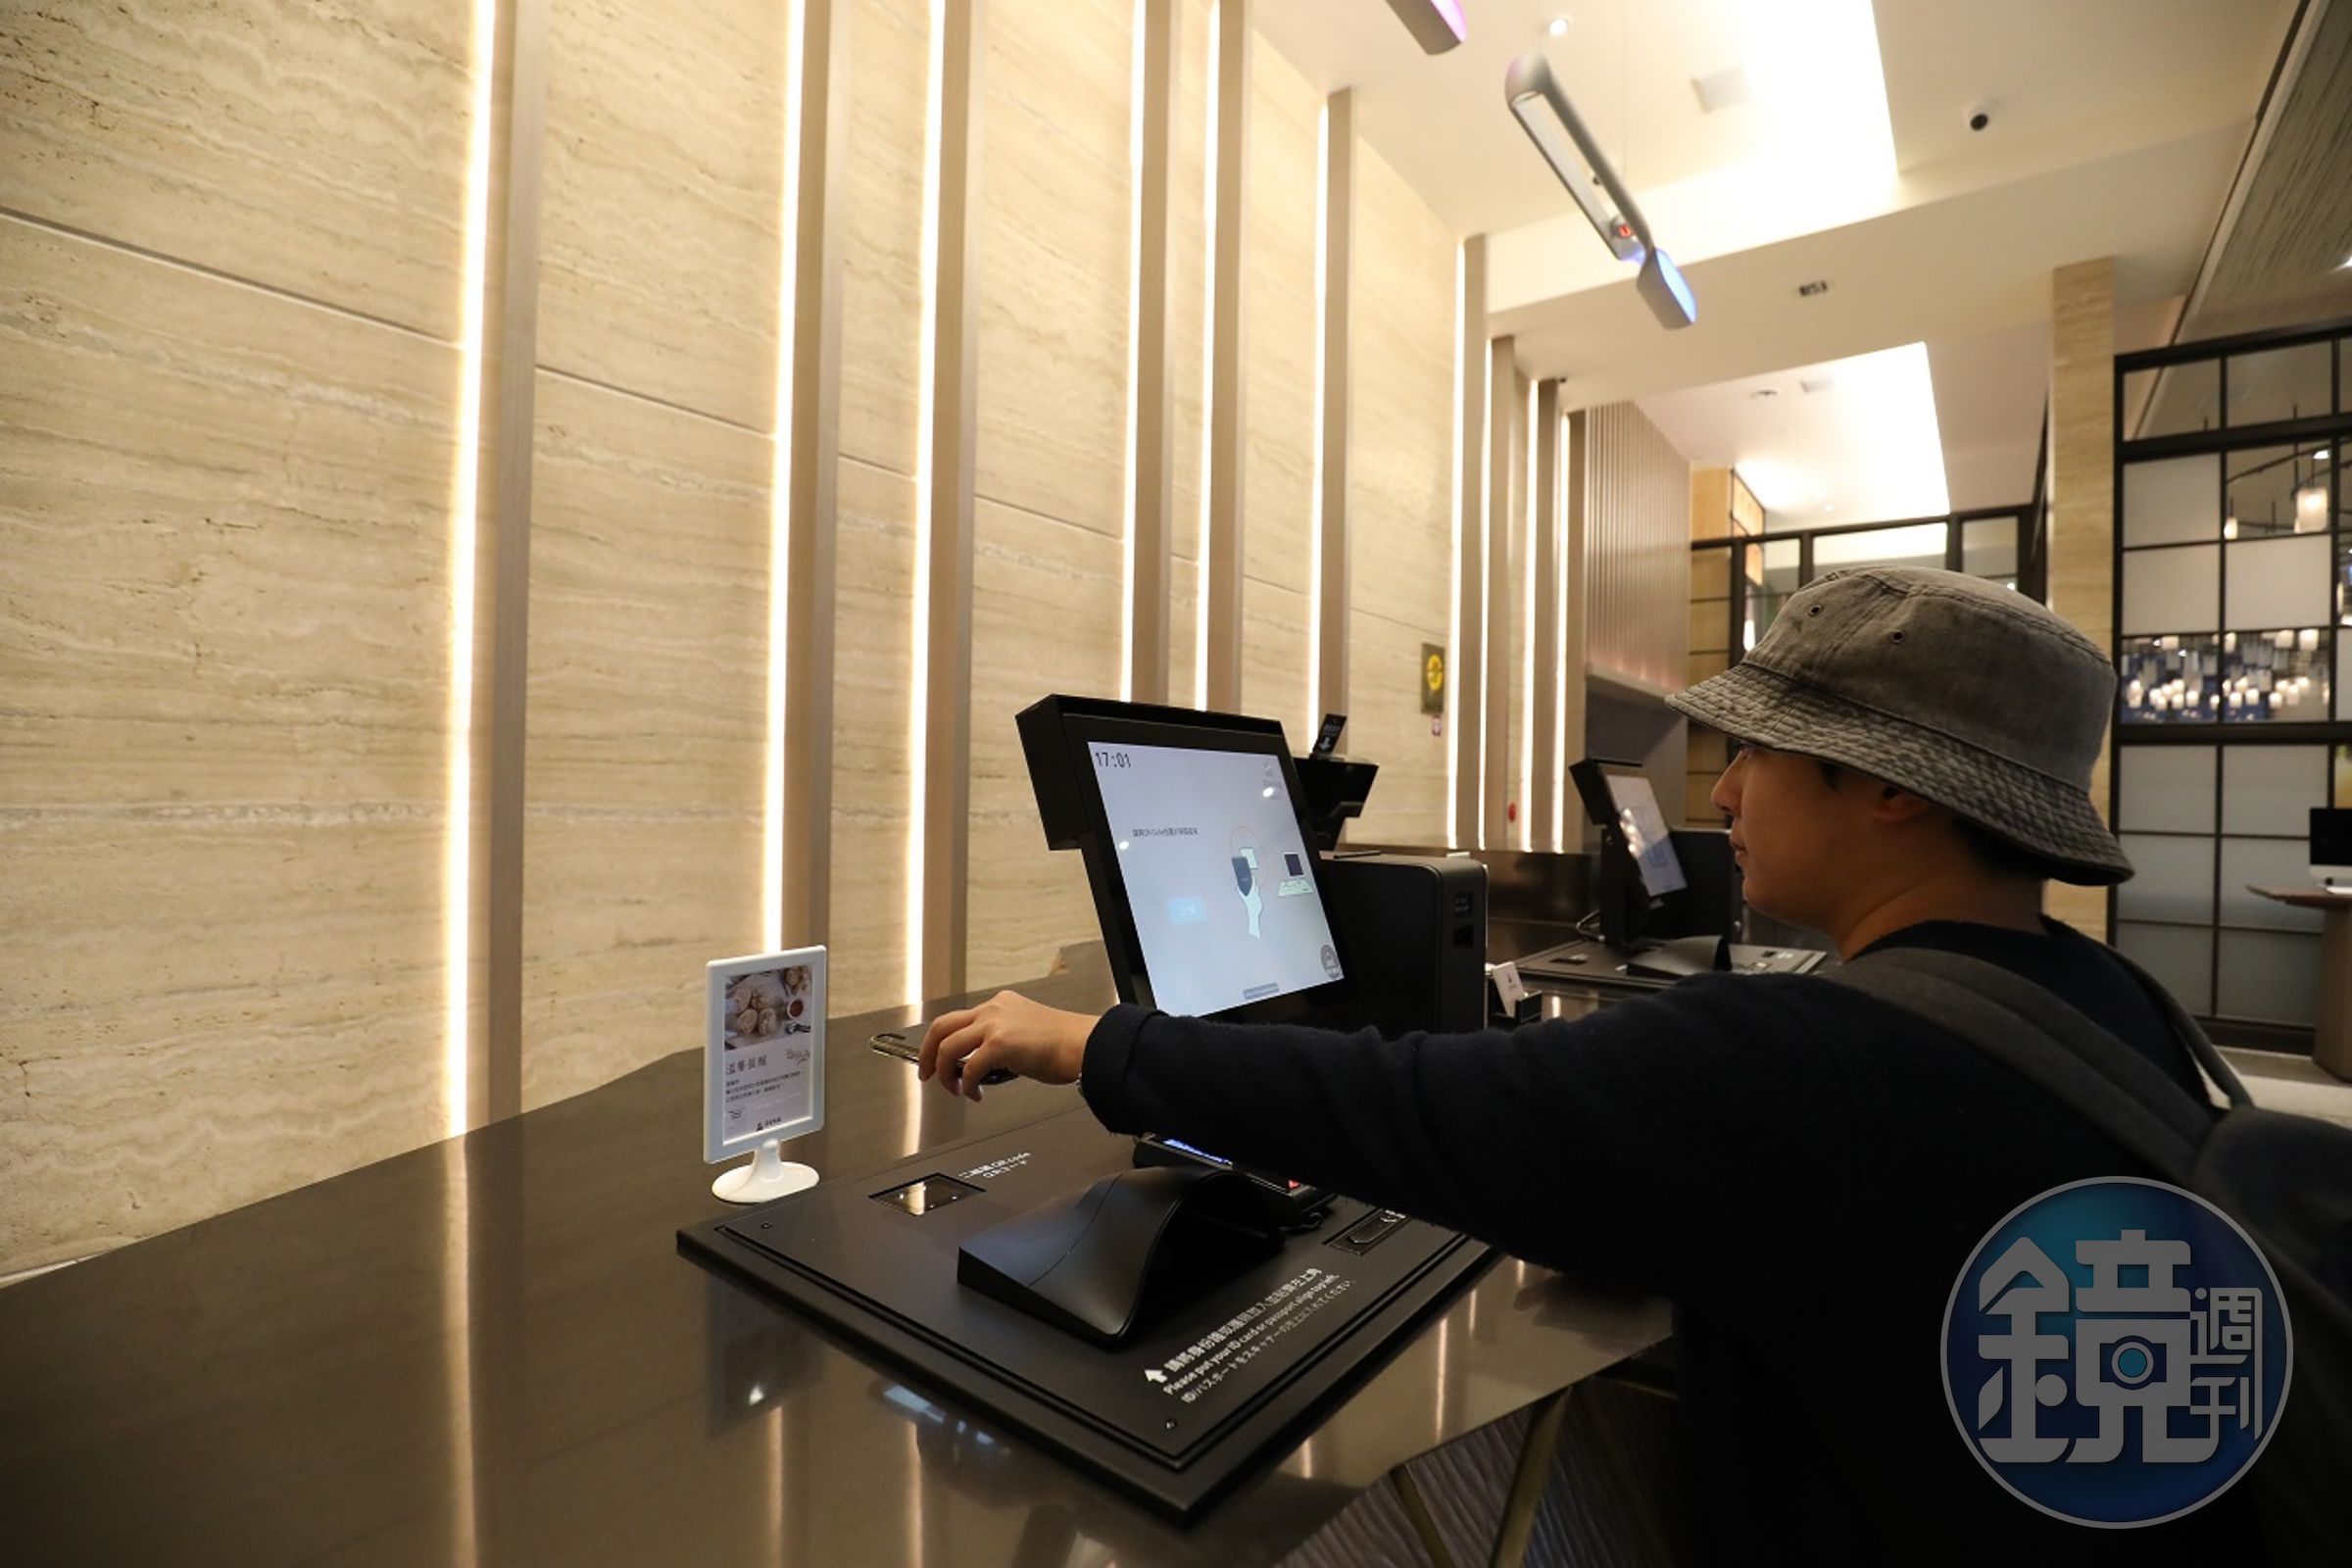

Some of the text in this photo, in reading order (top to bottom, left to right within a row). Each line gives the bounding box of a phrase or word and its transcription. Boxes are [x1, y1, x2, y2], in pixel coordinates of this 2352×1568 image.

[1095, 752, 1131, 768] 17:01
[1163, 1372, 1198, 1396] Please
[1195, 1360, 1214, 1376] put
[1209, 1347, 1232, 1365] your
[1227, 1340, 1242, 1349] ID
[1239, 1328, 1259, 1344] card
